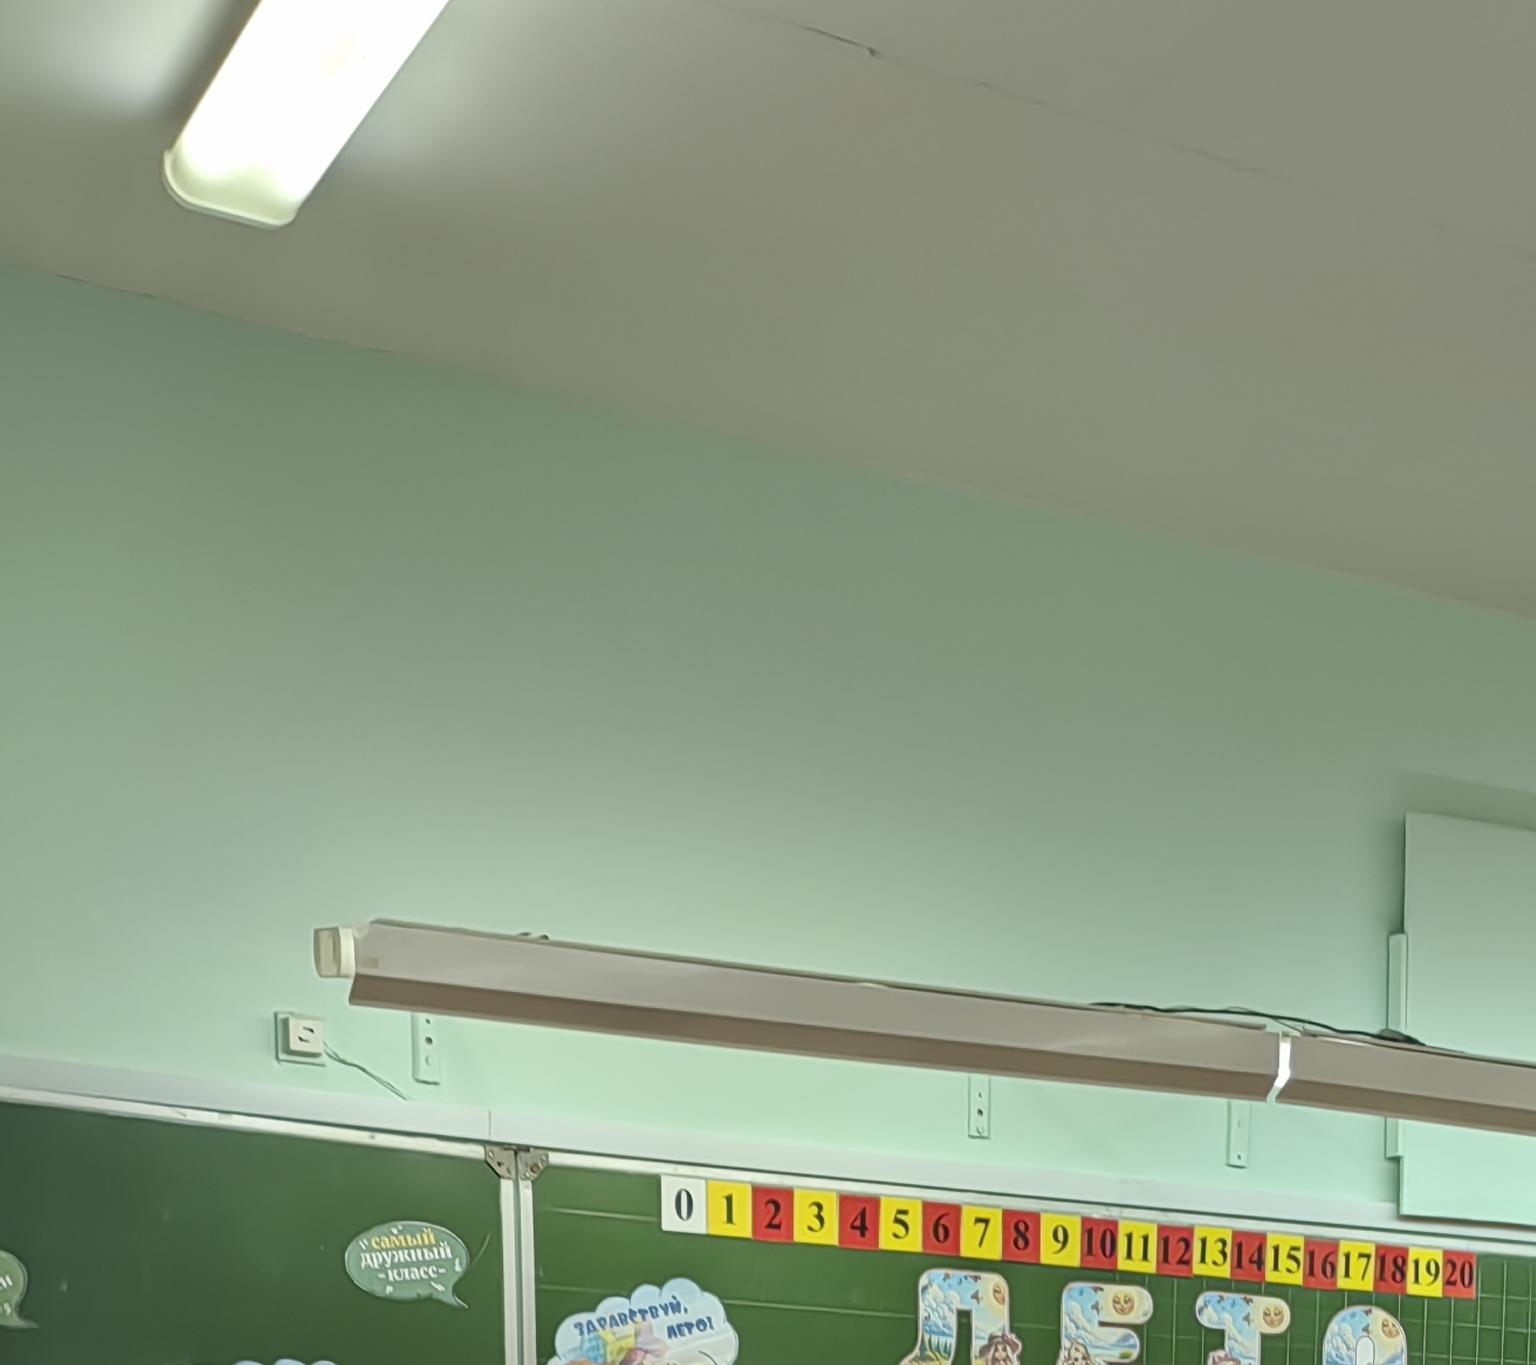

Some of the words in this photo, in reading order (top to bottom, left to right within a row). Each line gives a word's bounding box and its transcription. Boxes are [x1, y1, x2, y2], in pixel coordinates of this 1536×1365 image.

[371, 1227, 437, 1249] самый
[674, 1188, 694, 1222] 0
[721, 1193, 737, 1226] 1
[764, 1197, 782, 1231] 2
[807, 1201, 825, 1234] 3
[850, 1205, 869, 1238] 4
[892, 1208, 910, 1240] 5
[932, 1211, 950, 1244] 6
[973, 1216, 991, 1249] 7
[1012, 1219, 1030, 1251] 8
[1052, 1223, 1069, 1255] 9
[1084, 1226, 1117, 1260] 10
[1123, 1230, 1152, 1264] 11
[1161, 1234, 1192, 1267] 12
[1198, 1235, 1228, 1268] 13
[1234, 1239, 1264, 1272] 14
[1271, 1243, 1301, 1275] 15
[1307, 1248, 1336, 1280] 16
[1343, 1251, 1372, 1283] 17
[1377, 1254, 1407, 1285] 18
[1411, 1257, 1441, 1287] 19
[1445, 1259, 1474, 1289] 20
[360, 1241, 453, 1270] дружный
